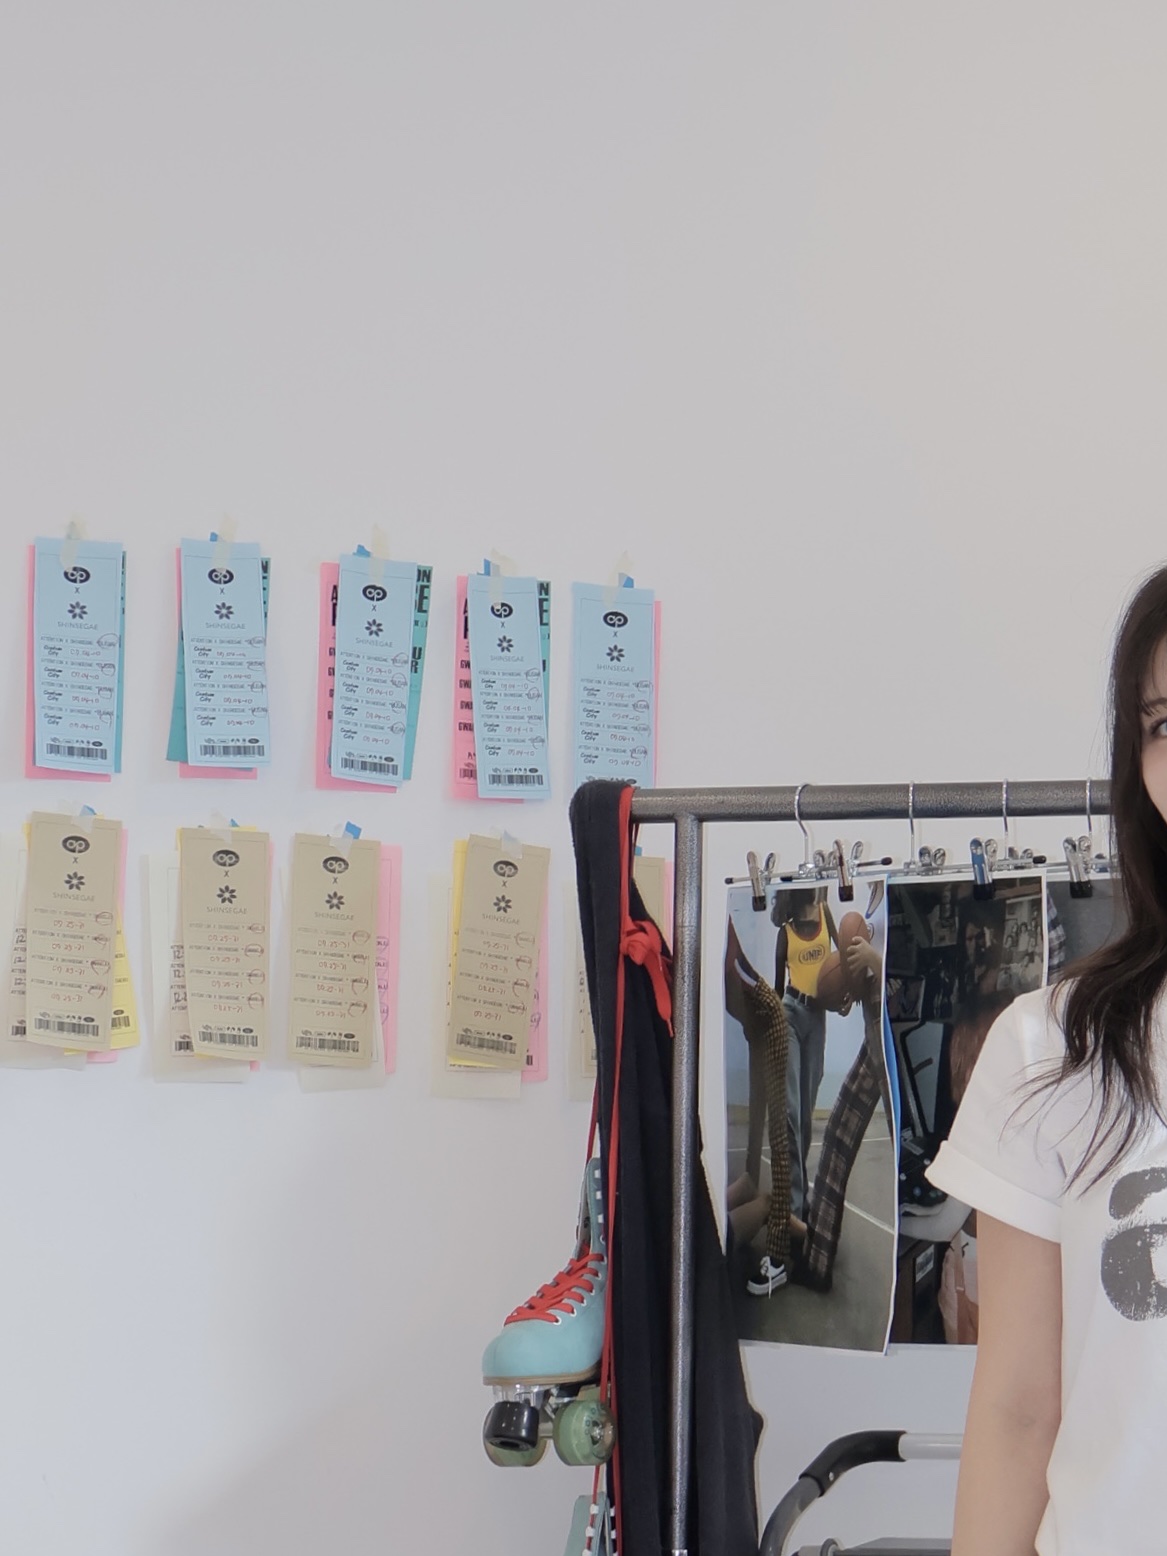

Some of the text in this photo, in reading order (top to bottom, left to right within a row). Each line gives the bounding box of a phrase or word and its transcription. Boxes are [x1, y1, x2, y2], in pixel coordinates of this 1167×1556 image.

[57, 621, 98, 630] SHINSEGAE
[355, 637, 393, 648] SHINSEGAE
[596, 663, 635, 672] SHINSEGAE
[52, 892, 95, 902] SHINSEGAE
[206, 906, 248, 914] SHINSEGAE
[314, 911, 354, 921] SHINSEGAE
[482, 913, 520, 925] SHINSEGAE
